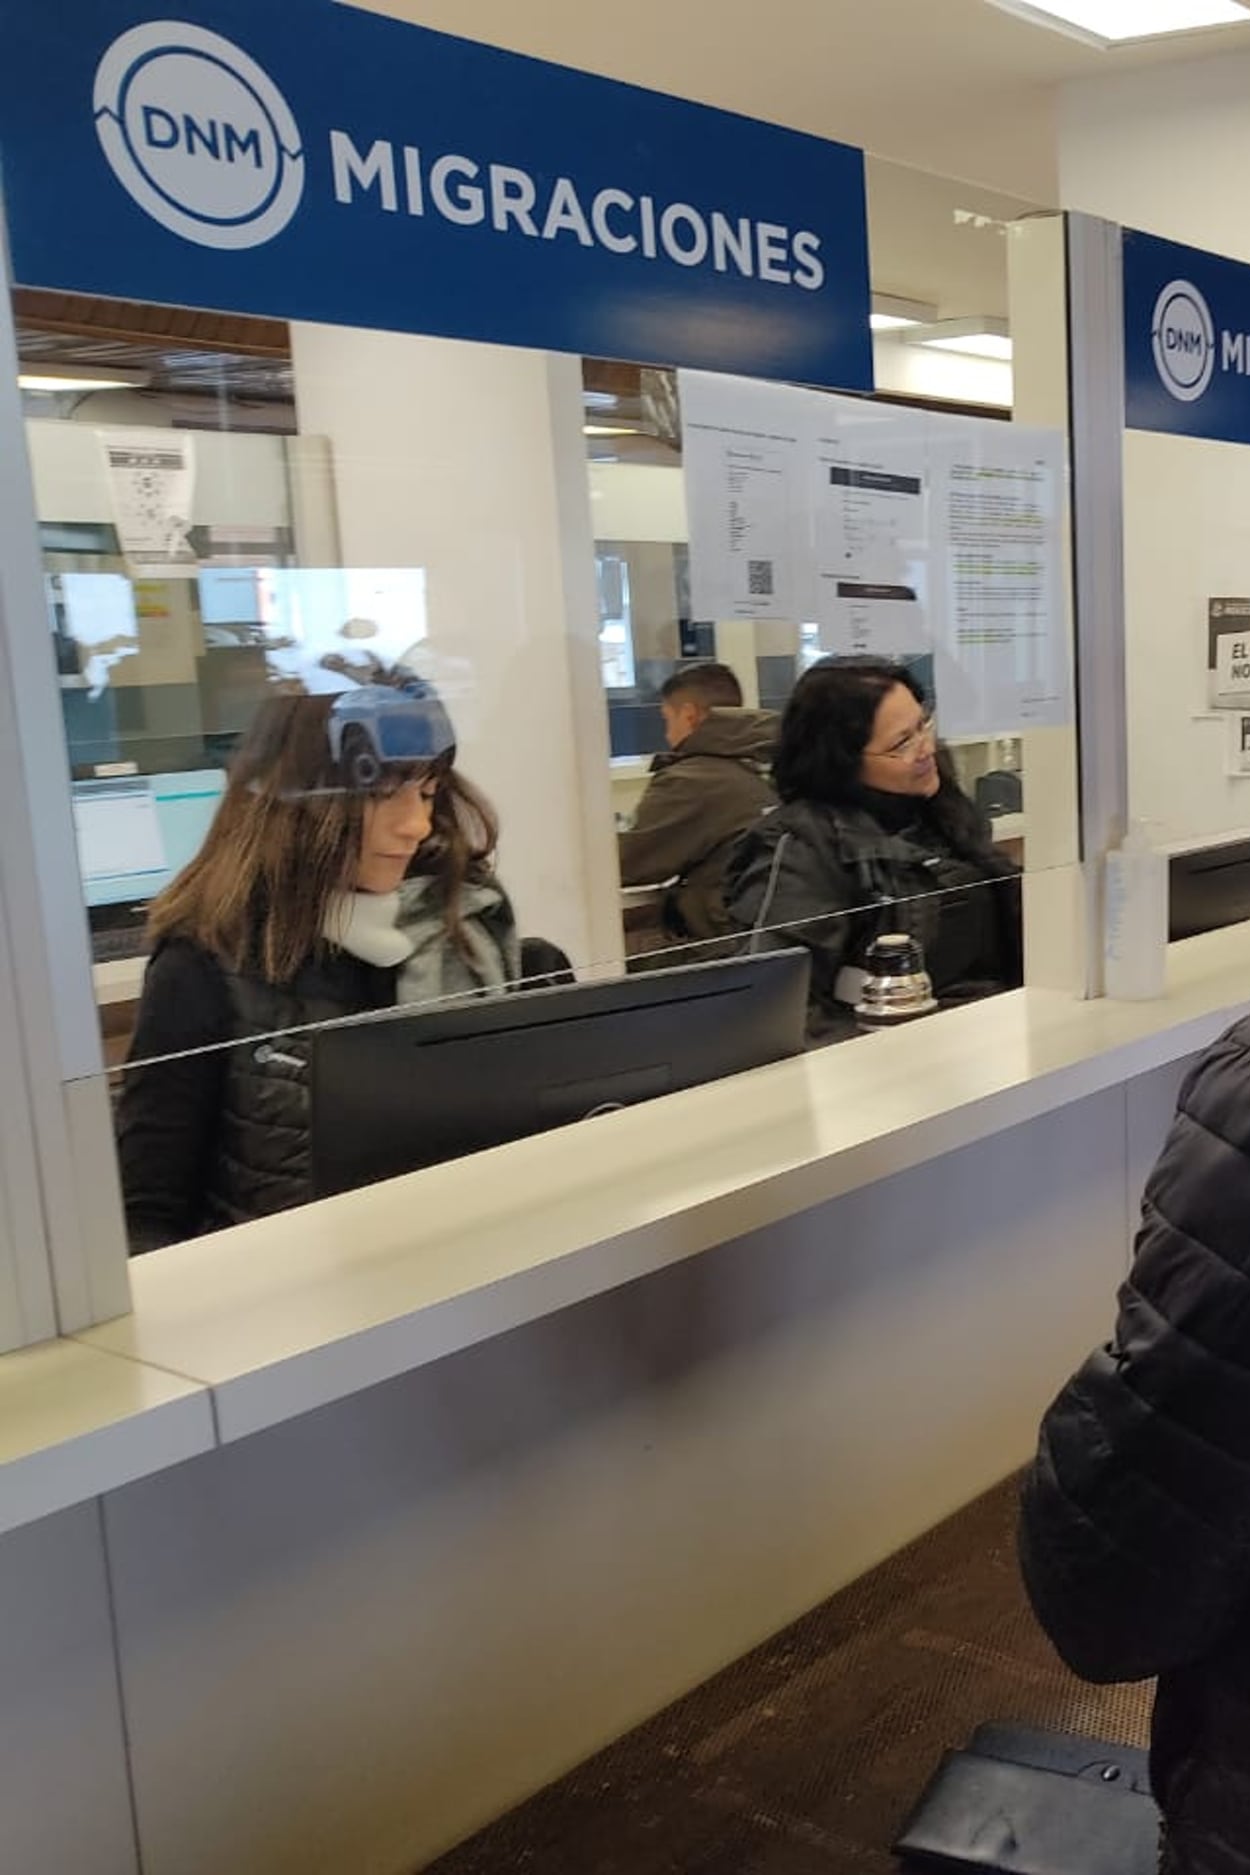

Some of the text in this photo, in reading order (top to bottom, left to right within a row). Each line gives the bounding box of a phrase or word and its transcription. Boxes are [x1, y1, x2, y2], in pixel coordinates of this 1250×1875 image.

[142, 105, 826, 291] DNM MIGRACIONES
[1165, 327, 1201, 353] DNM
[1232, 643, 1248, 659] EL
